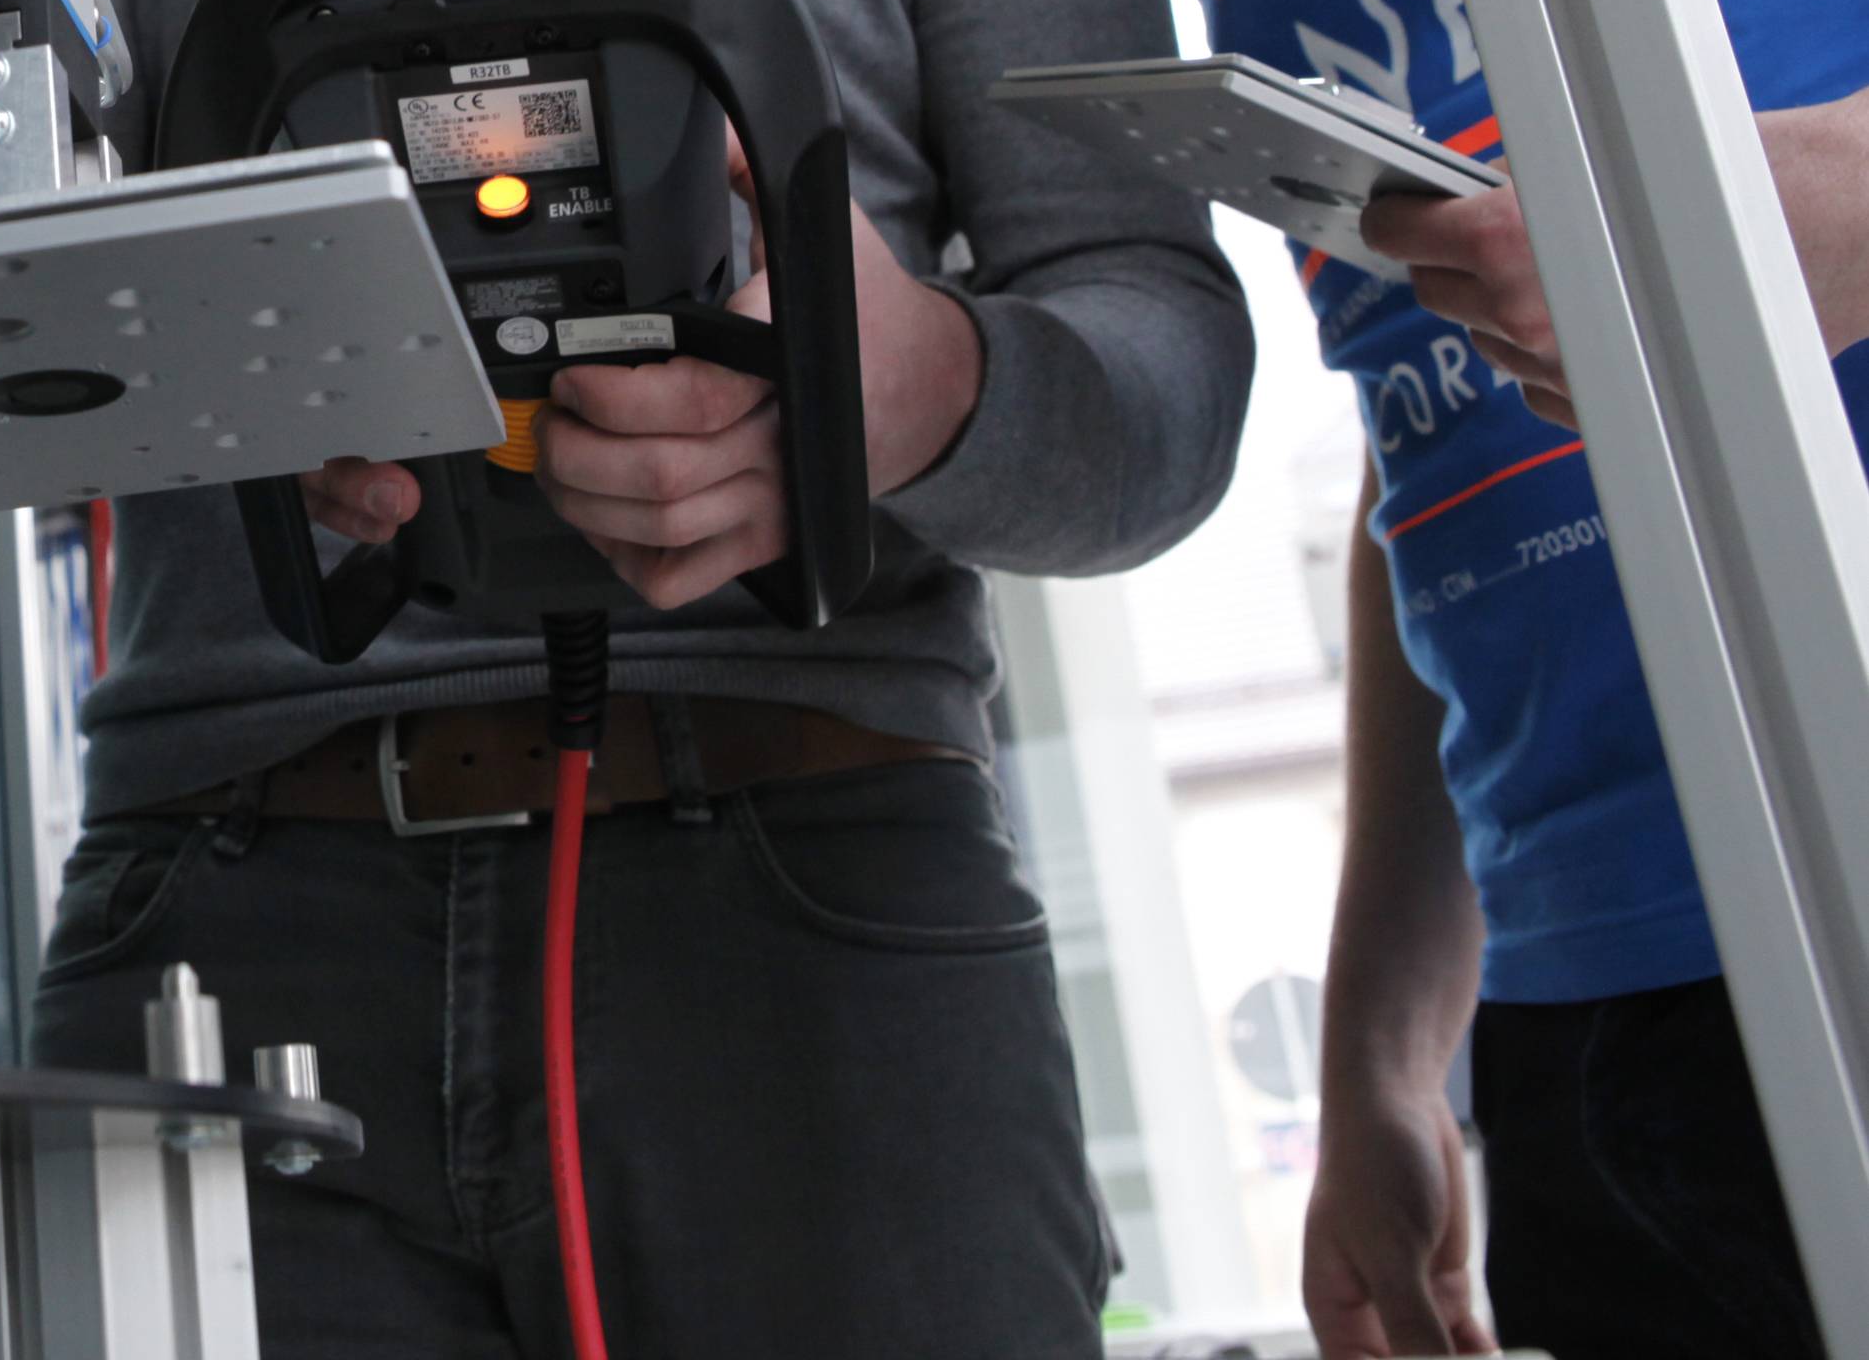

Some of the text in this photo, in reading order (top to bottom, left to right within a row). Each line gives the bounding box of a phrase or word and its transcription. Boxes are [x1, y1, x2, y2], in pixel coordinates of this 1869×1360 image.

[469, 63, 512, 80] R32TB
[453, 93, 486, 112] CE
[569, 187, 591, 200] TB
[548, 197, 614, 219] ENABLE
